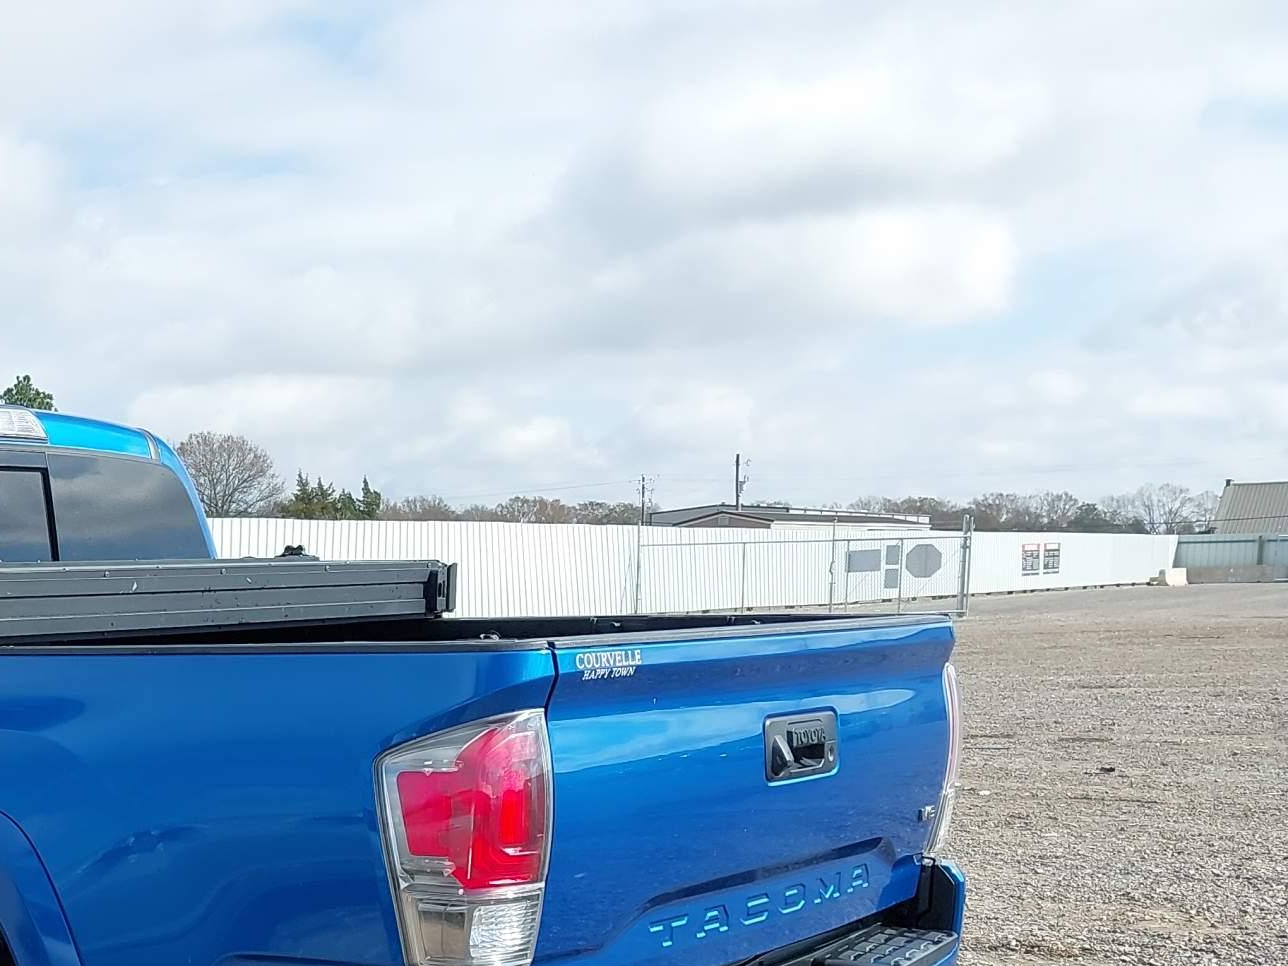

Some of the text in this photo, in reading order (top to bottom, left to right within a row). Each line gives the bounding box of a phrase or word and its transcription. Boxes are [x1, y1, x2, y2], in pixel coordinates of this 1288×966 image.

[575, 649, 642, 669] COURVELLE
[582, 666, 636, 681] HAPPY TOWN
[648, 863, 870, 947] TACOMA
